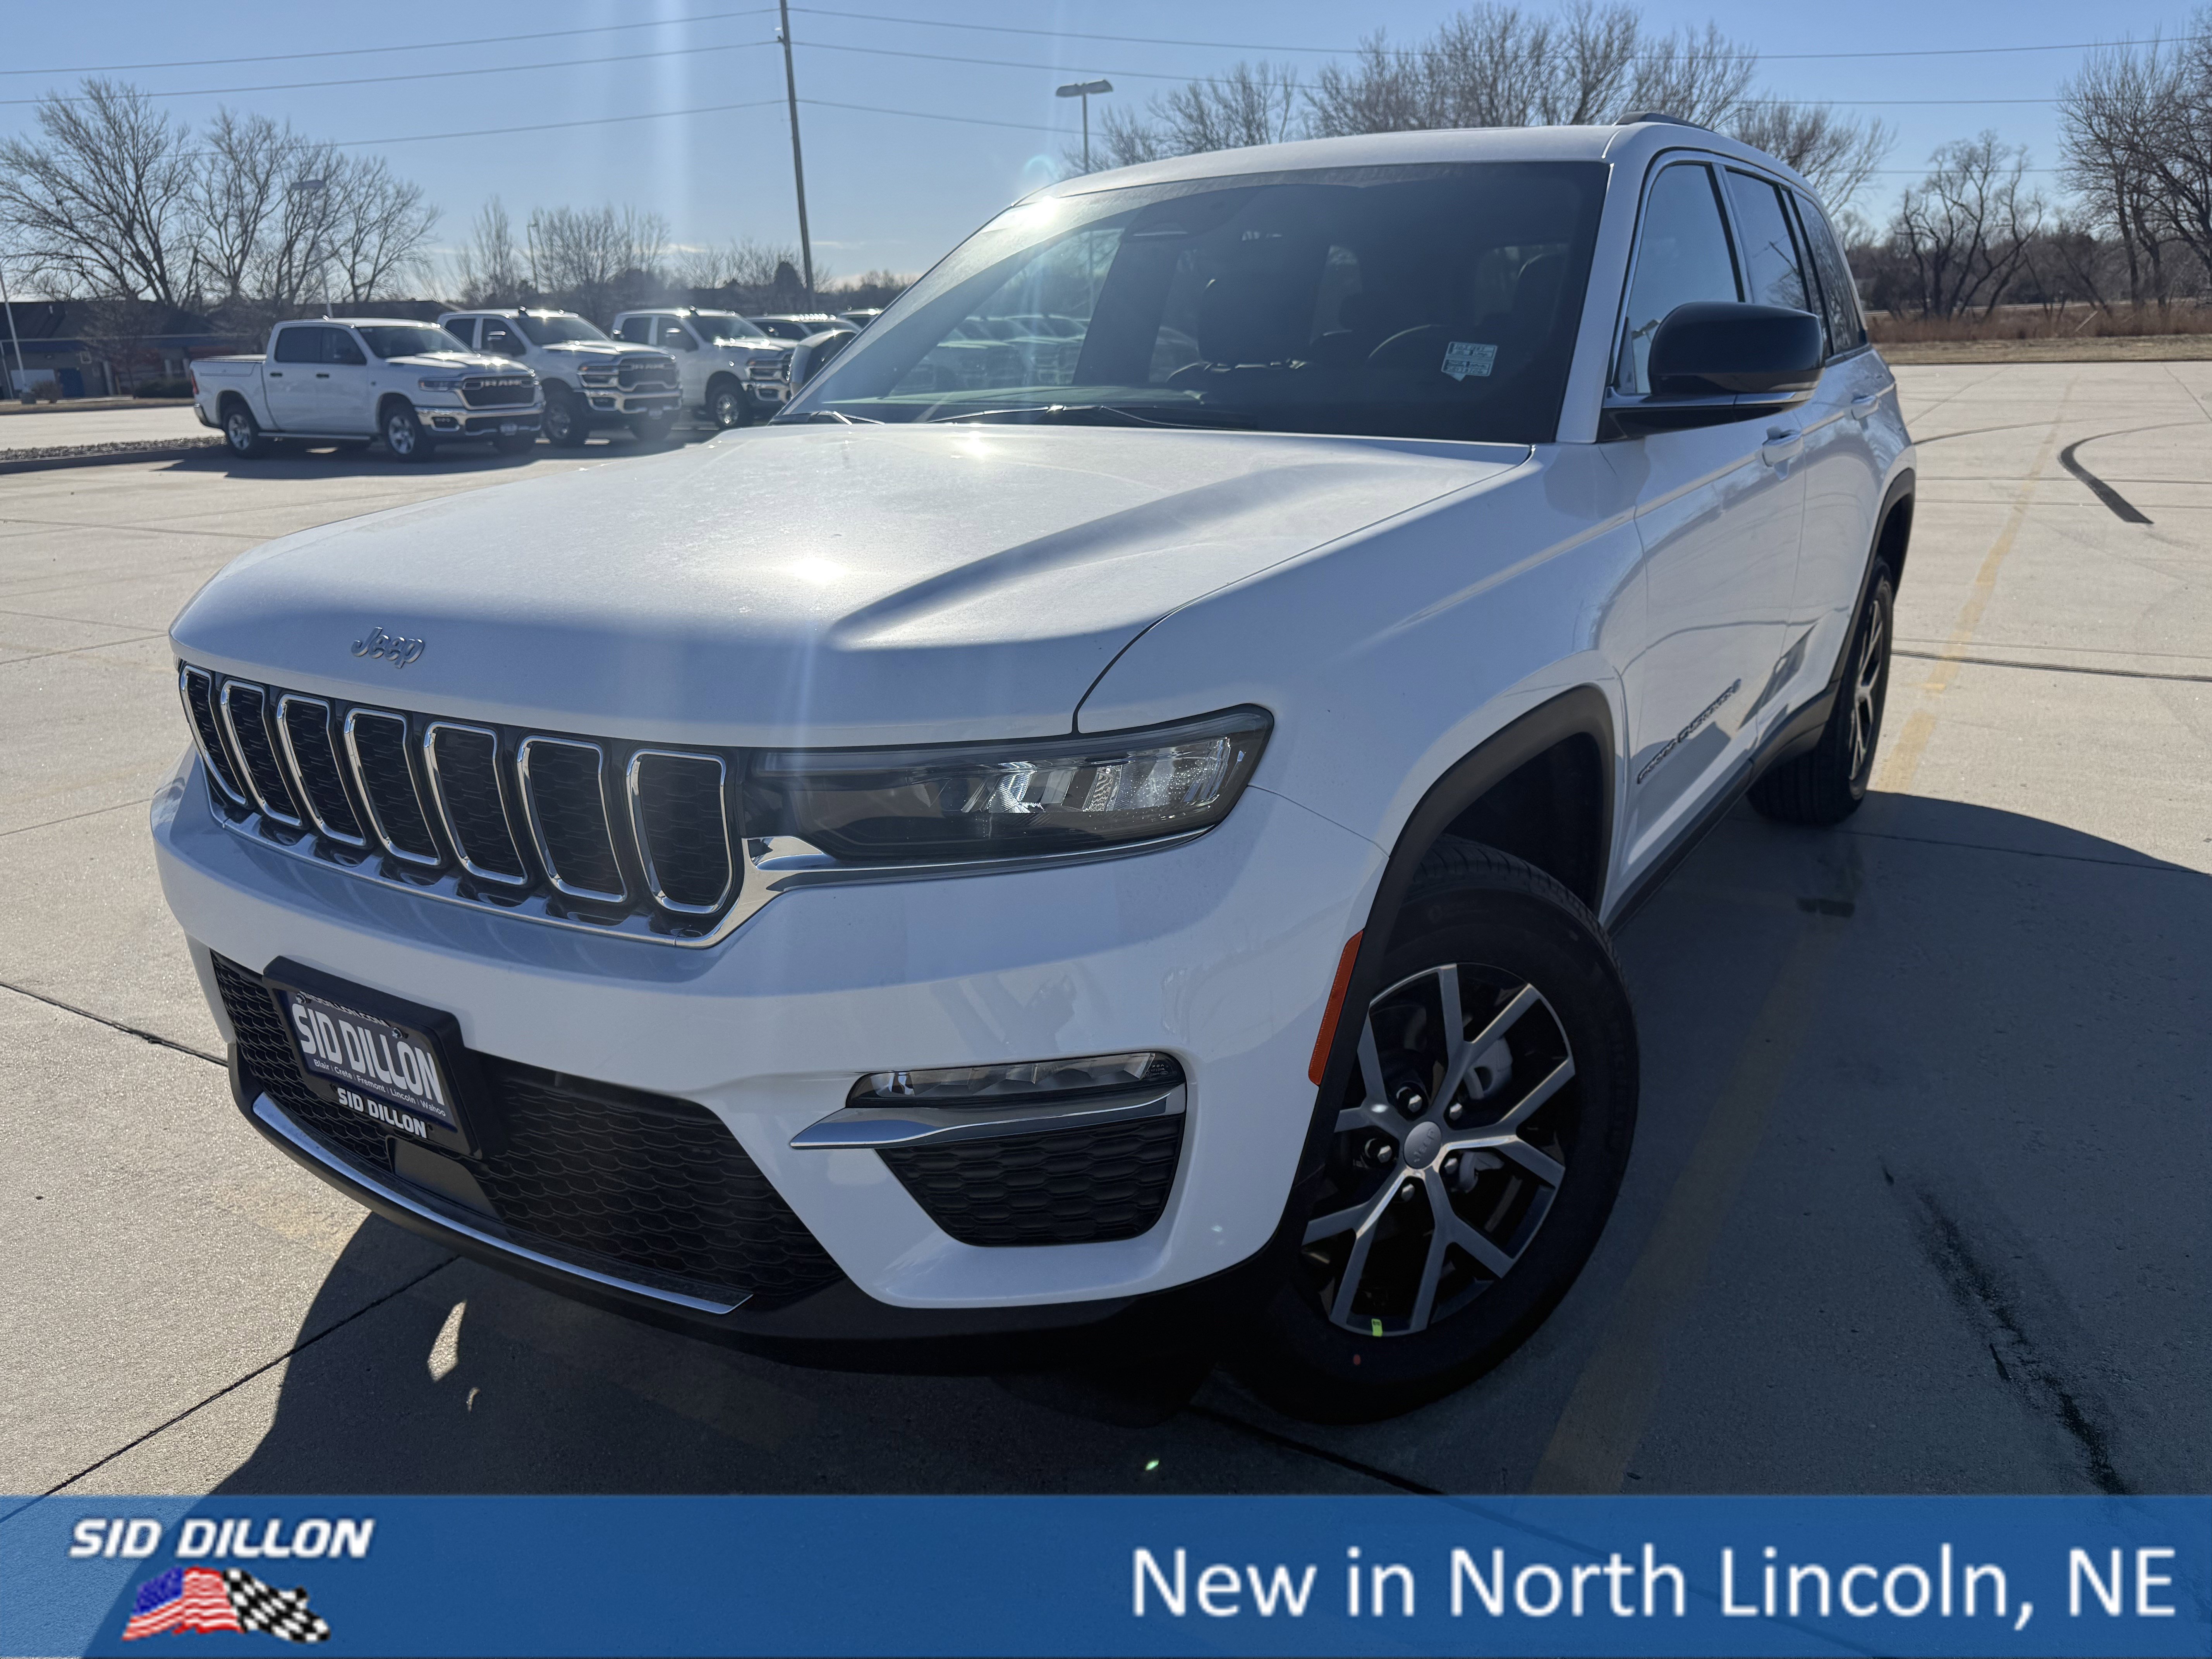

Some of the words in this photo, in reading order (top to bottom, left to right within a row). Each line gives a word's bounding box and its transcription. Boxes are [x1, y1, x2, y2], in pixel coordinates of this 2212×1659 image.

[351, 627, 425, 669] Jeep
[292, 1003, 343, 1065] SID
[338, 1019, 445, 1106] DILLON
[313, 1059, 330, 1070] Blair
[334, 1066, 352, 1079] Crete
[356, 1075, 386, 1092] Fremont
[390, 1088, 416, 1104] Lincoln
[420, 1100, 446, 1116] Wahoo
[337, 1087, 364, 1112] SID
[367, 1099, 427, 1139] DILLON
[1413, 1127, 1437, 1163] Jeep
